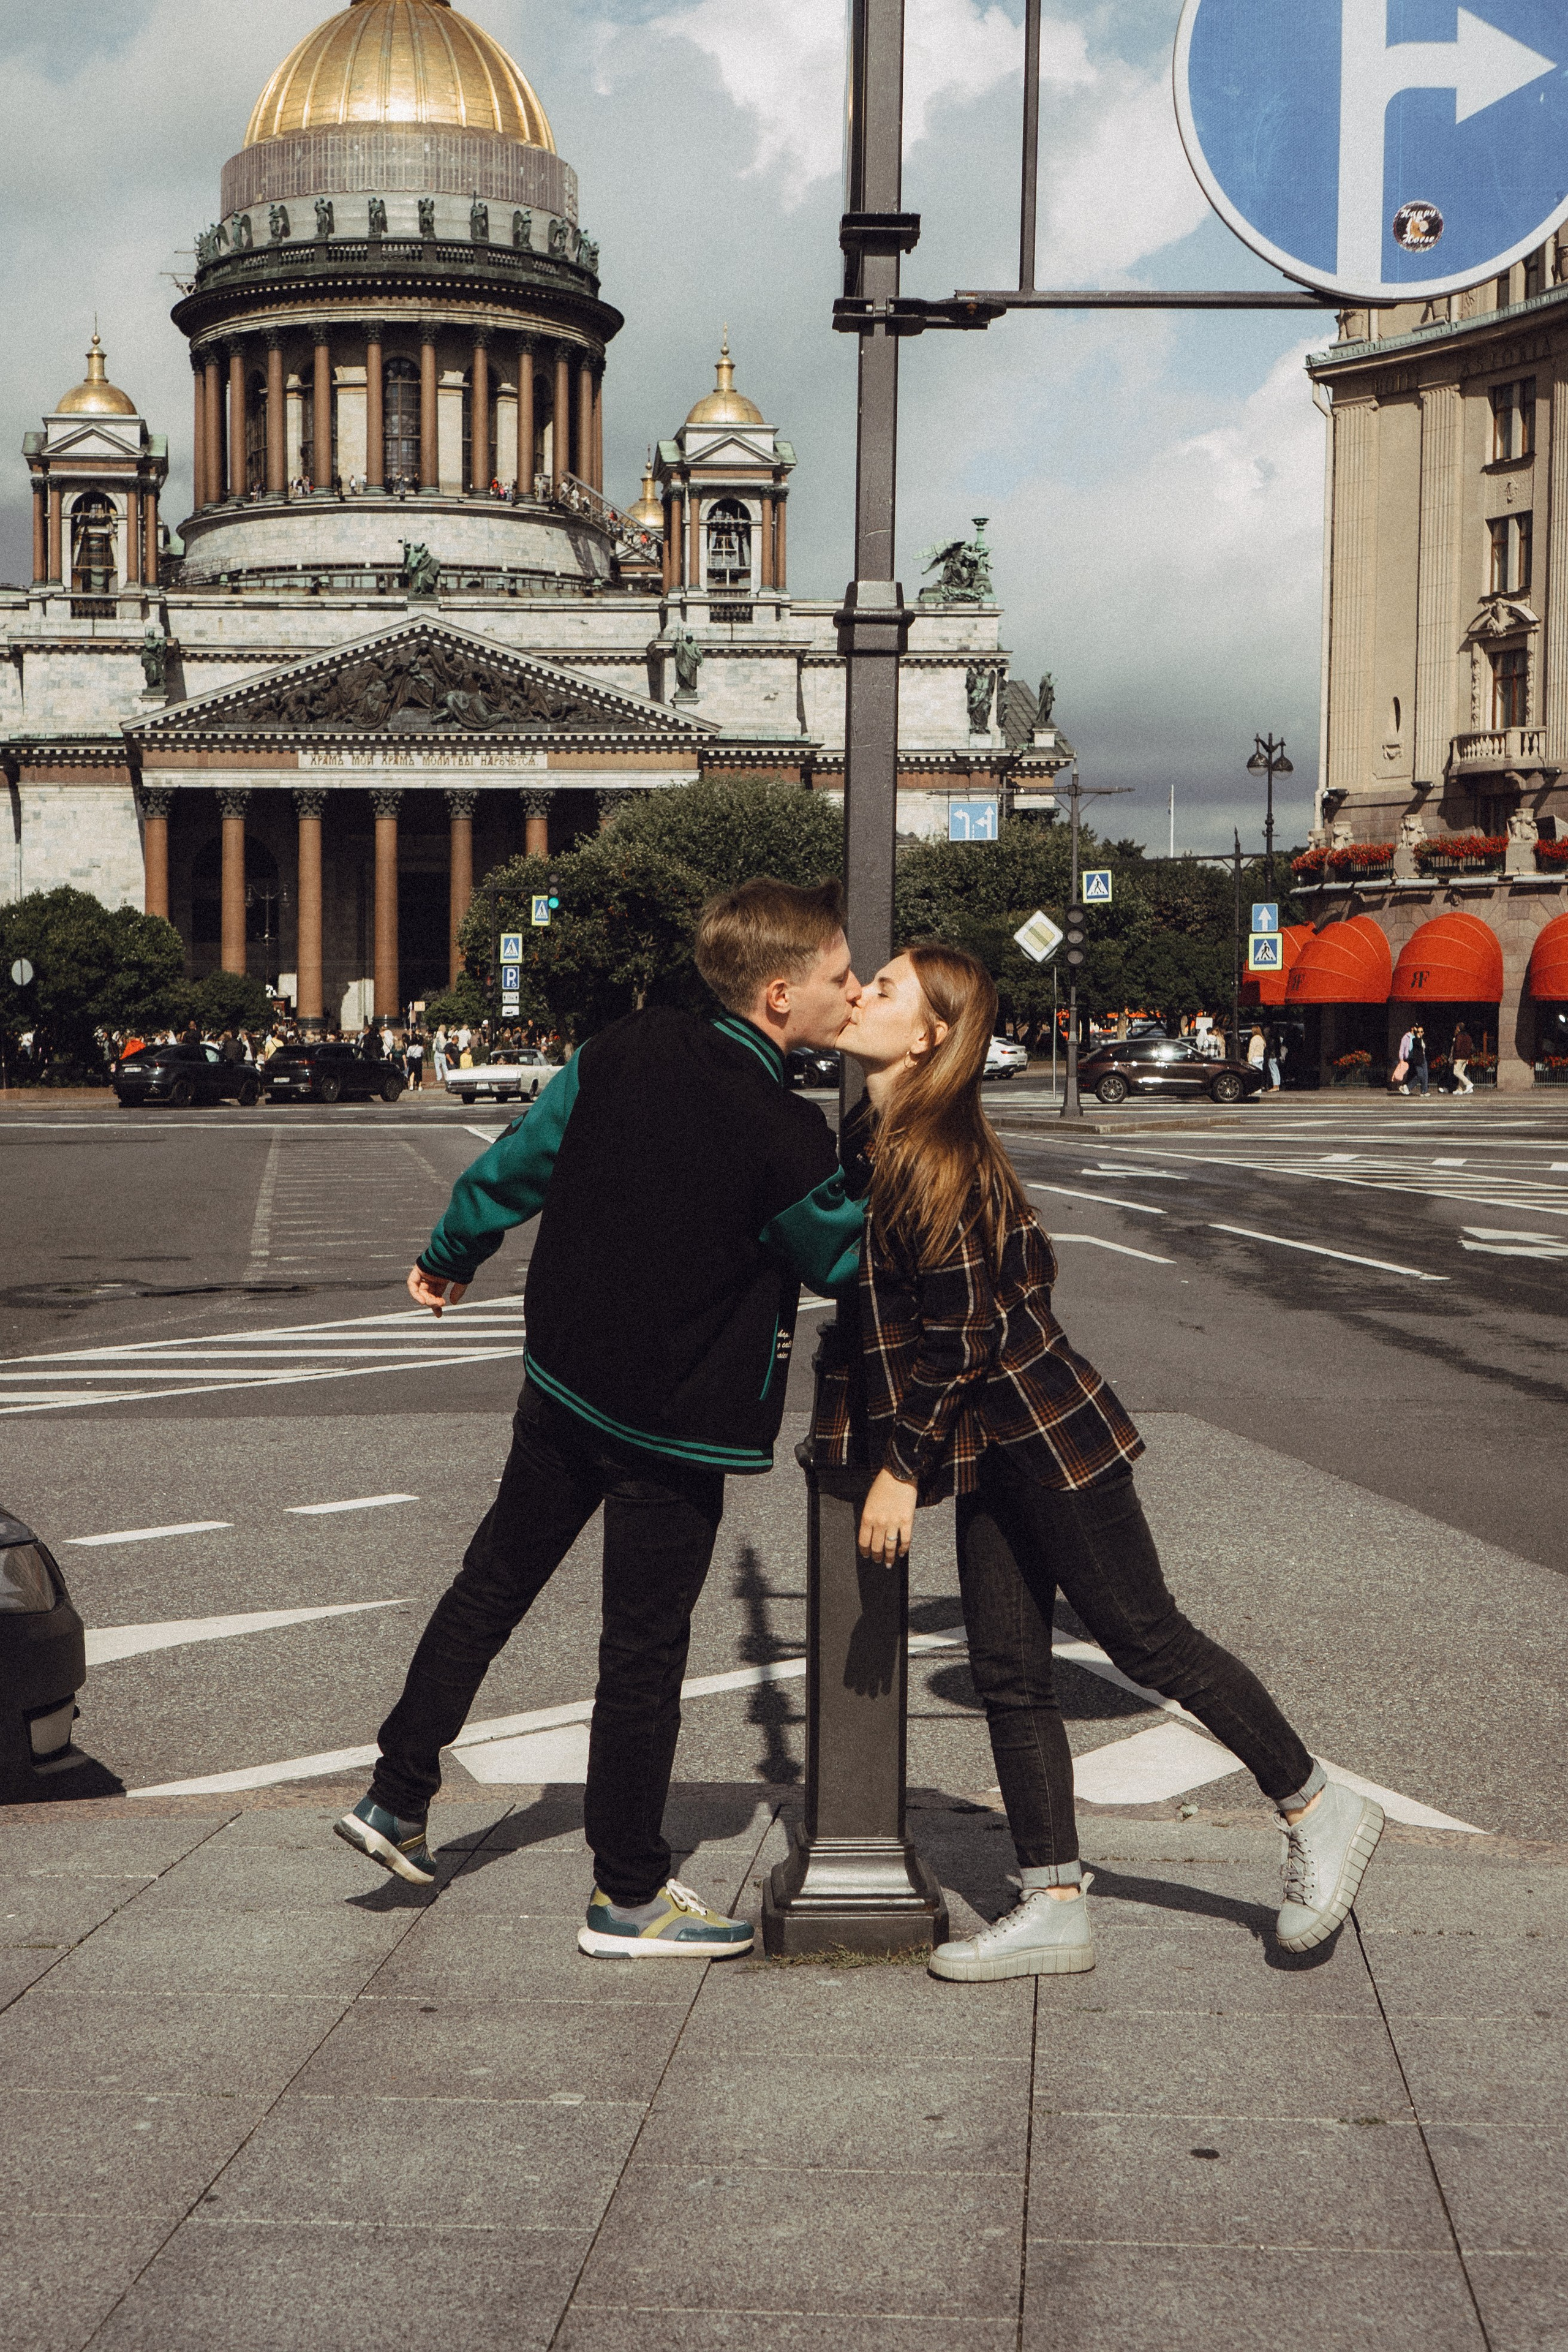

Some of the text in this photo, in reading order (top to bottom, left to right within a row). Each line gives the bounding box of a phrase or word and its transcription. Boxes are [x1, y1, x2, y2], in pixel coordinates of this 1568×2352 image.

[1400, 208, 1436, 222] Happy
[1402, 233, 1435, 244] Horse
[311, 755, 344, 765] ХРАМЪ
[382, 755, 414, 765] ХРАМЪ
[507, 968, 516, 987] P
